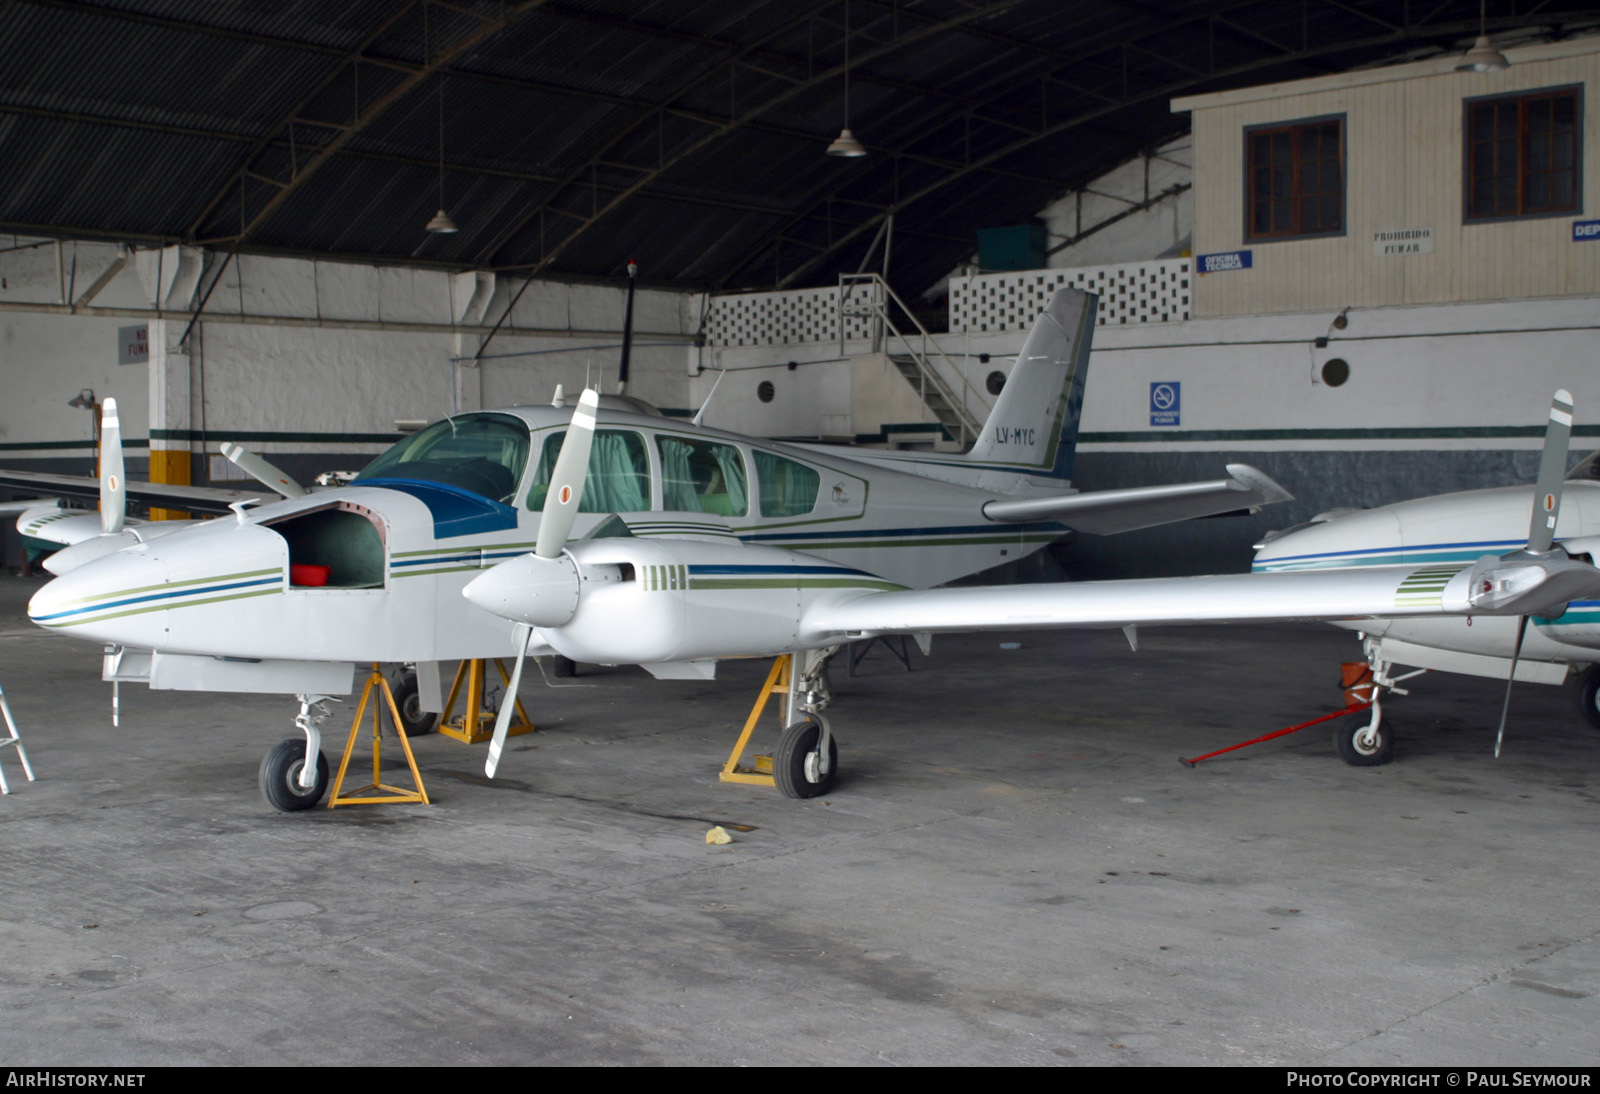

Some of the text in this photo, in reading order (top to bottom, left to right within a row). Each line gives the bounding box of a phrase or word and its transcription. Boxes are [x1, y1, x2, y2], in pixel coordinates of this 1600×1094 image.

[1384, 244, 1420, 254] FUMAR
[1205, 254, 1239, 264] OFICINA
[1205, 261, 1242, 271] TECNICA
[136, 329, 146, 341] NO
[996, 427, 1035, 446] LV-MYC
